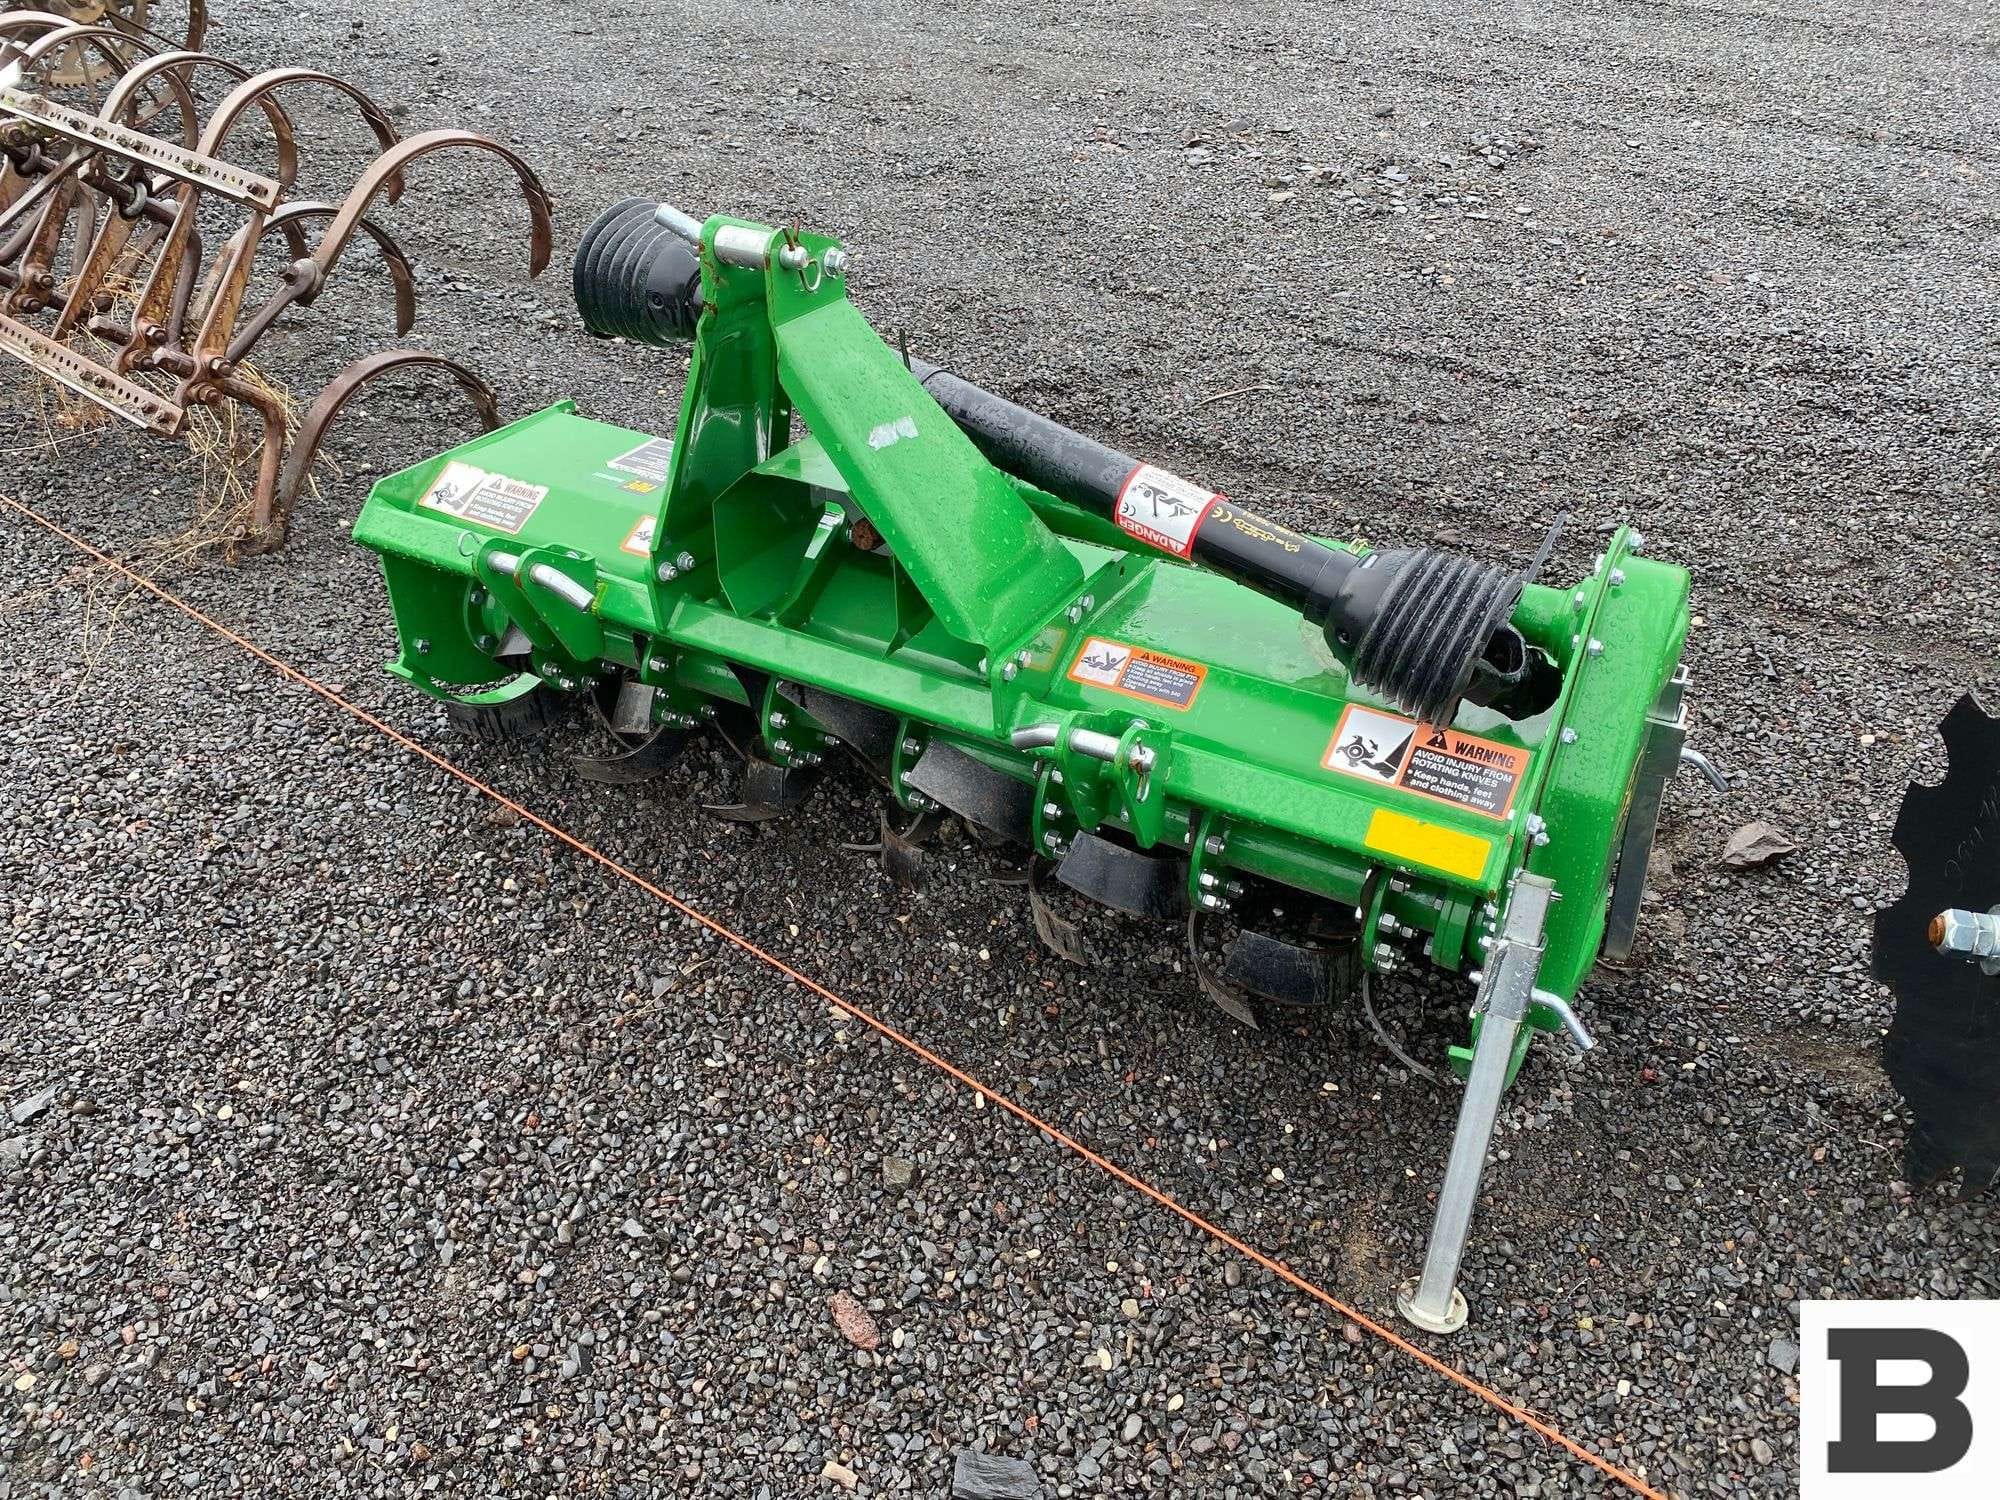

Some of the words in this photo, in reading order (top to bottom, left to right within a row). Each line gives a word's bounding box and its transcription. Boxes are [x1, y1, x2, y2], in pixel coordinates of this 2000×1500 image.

[505, 483, 540, 500] WARNING
[1119, 518, 1169, 549] DANGER
[1152, 655, 1195, 673] WARNING
[1414, 749, 1444, 764] AVOID
[1446, 757, 1482, 773] INJURY
[1482, 767, 1513, 783] FROM
[1454, 740, 1516, 769] WARNING
[1411, 757, 1460, 777] ROTATING
[1461, 770, 1499, 788] KNIVES
[1413, 769, 1438, 784] Keep
[1439, 776, 1471, 794] hands,
[1473, 787, 1492, 799] feet
[1410, 778, 1429, 790] and
[1430, 783, 1469, 803] clothing
[1470, 795, 1496, 810] away
